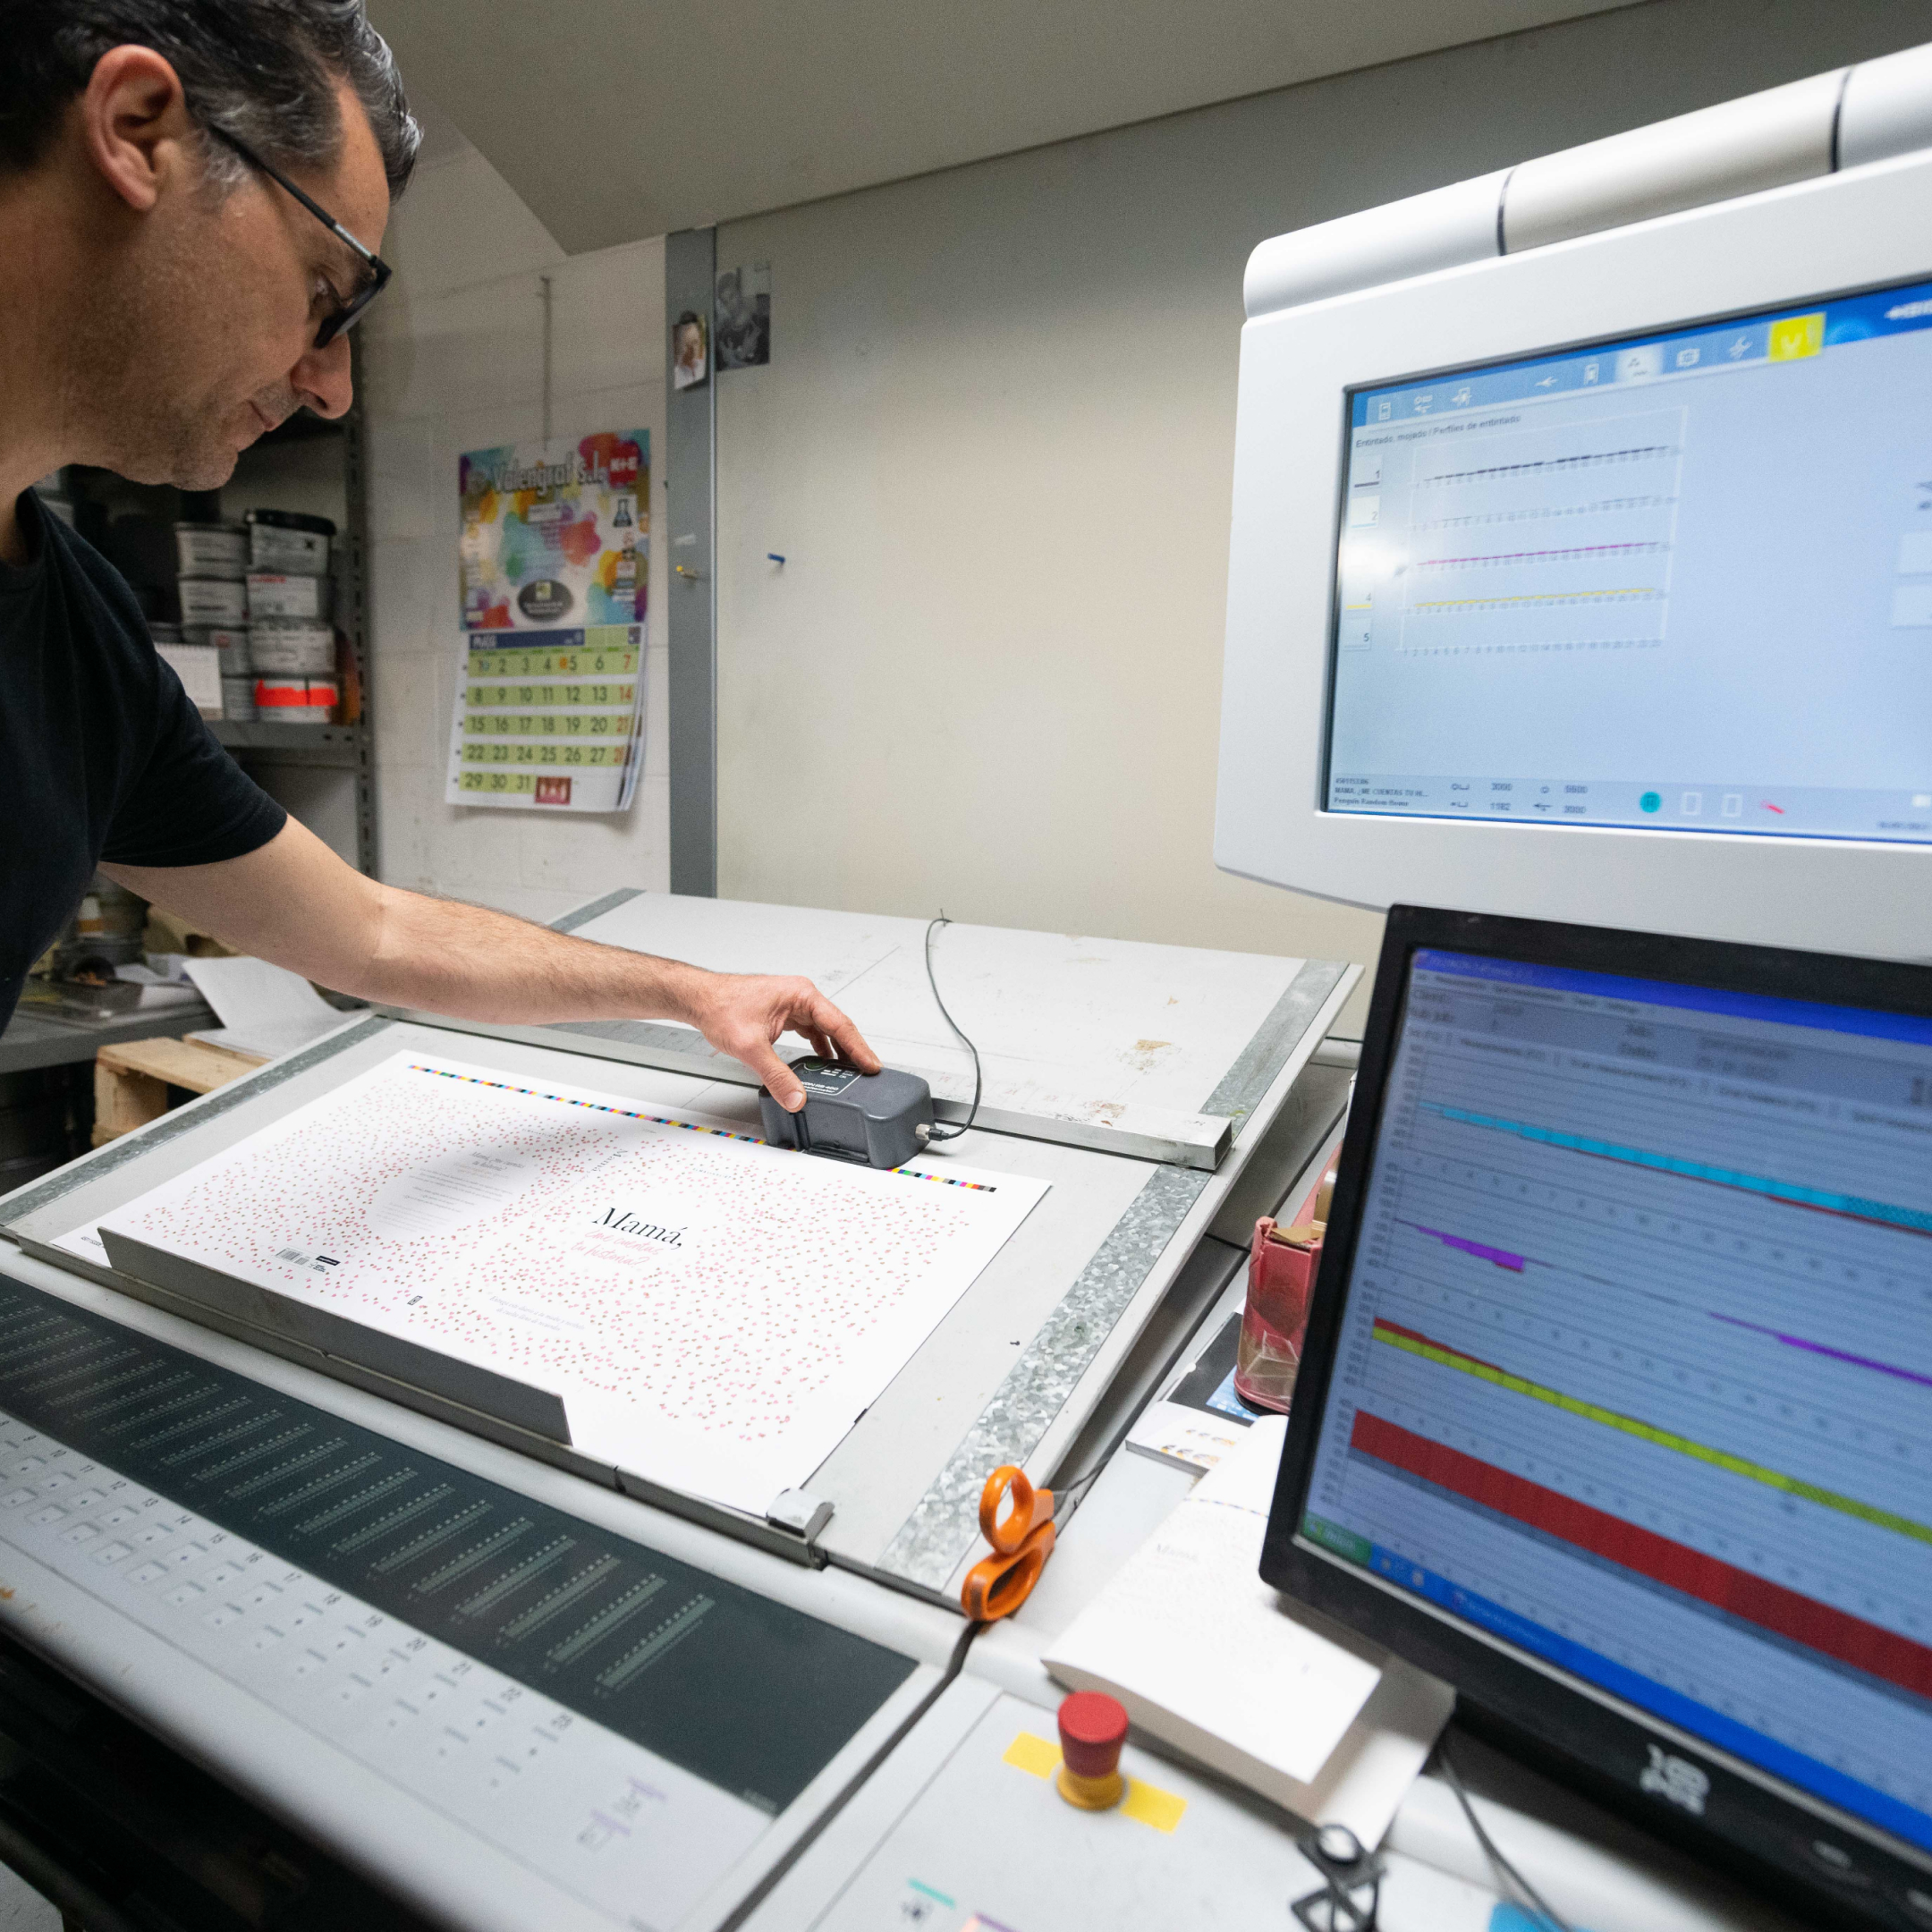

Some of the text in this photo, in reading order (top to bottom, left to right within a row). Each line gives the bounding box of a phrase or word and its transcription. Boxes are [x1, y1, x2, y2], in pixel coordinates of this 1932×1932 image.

[1433, 424, 1464, 436] Perfiles
[1467, 422, 1478, 430] de
[1375, 470, 1380, 479] 1
[1371, 512, 1378, 521] 2
[1366, 593, 1372, 602] 4
[1363, 632, 1369, 643] 5
[498, 658, 506, 673] 2
[522, 657, 530, 672] 3
[544, 657, 552, 671] 4
[569, 657, 578, 671] 5
[595, 656, 605, 671] 6
[623, 655, 631, 670] 7
[474, 686, 632, 703] 8 9 10 11 12 13 14
[471, 718, 485, 733] 15
[495, 718, 509, 733] 16
[519, 717, 533, 732] 17
[541, 717, 555, 732] 18
[565, 717, 581, 733] 19
[590, 718, 608, 733] 20
[468, 746, 484, 761] 22
[492, 746, 509, 761] 23
[516, 746, 533, 761] 24
[540, 746, 557, 762] 25
[564, 747, 581, 763] 26
[589, 748, 606, 763] 27
[465, 773, 531, 789] 29 30 31
[591, 1207, 689, 1250] Mamá,
[572, 1241, 651, 1267] tu historia?
[614, 1237, 665, 1256] cuentas
[79, 1464, 96, 1474] 11
[110, 1480, 127, 1491] 12
[141, 1496, 160, 1508] 13
[175, 1514, 193, 1526] 14
[208, 1532, 228, 1546] 15
[244, 1551, 264, 1564] 16
[283, 1571, 303, 1583] 17
[405, 1635, 428, 1652] 20
[451, 1659, 472, 1676] 21
